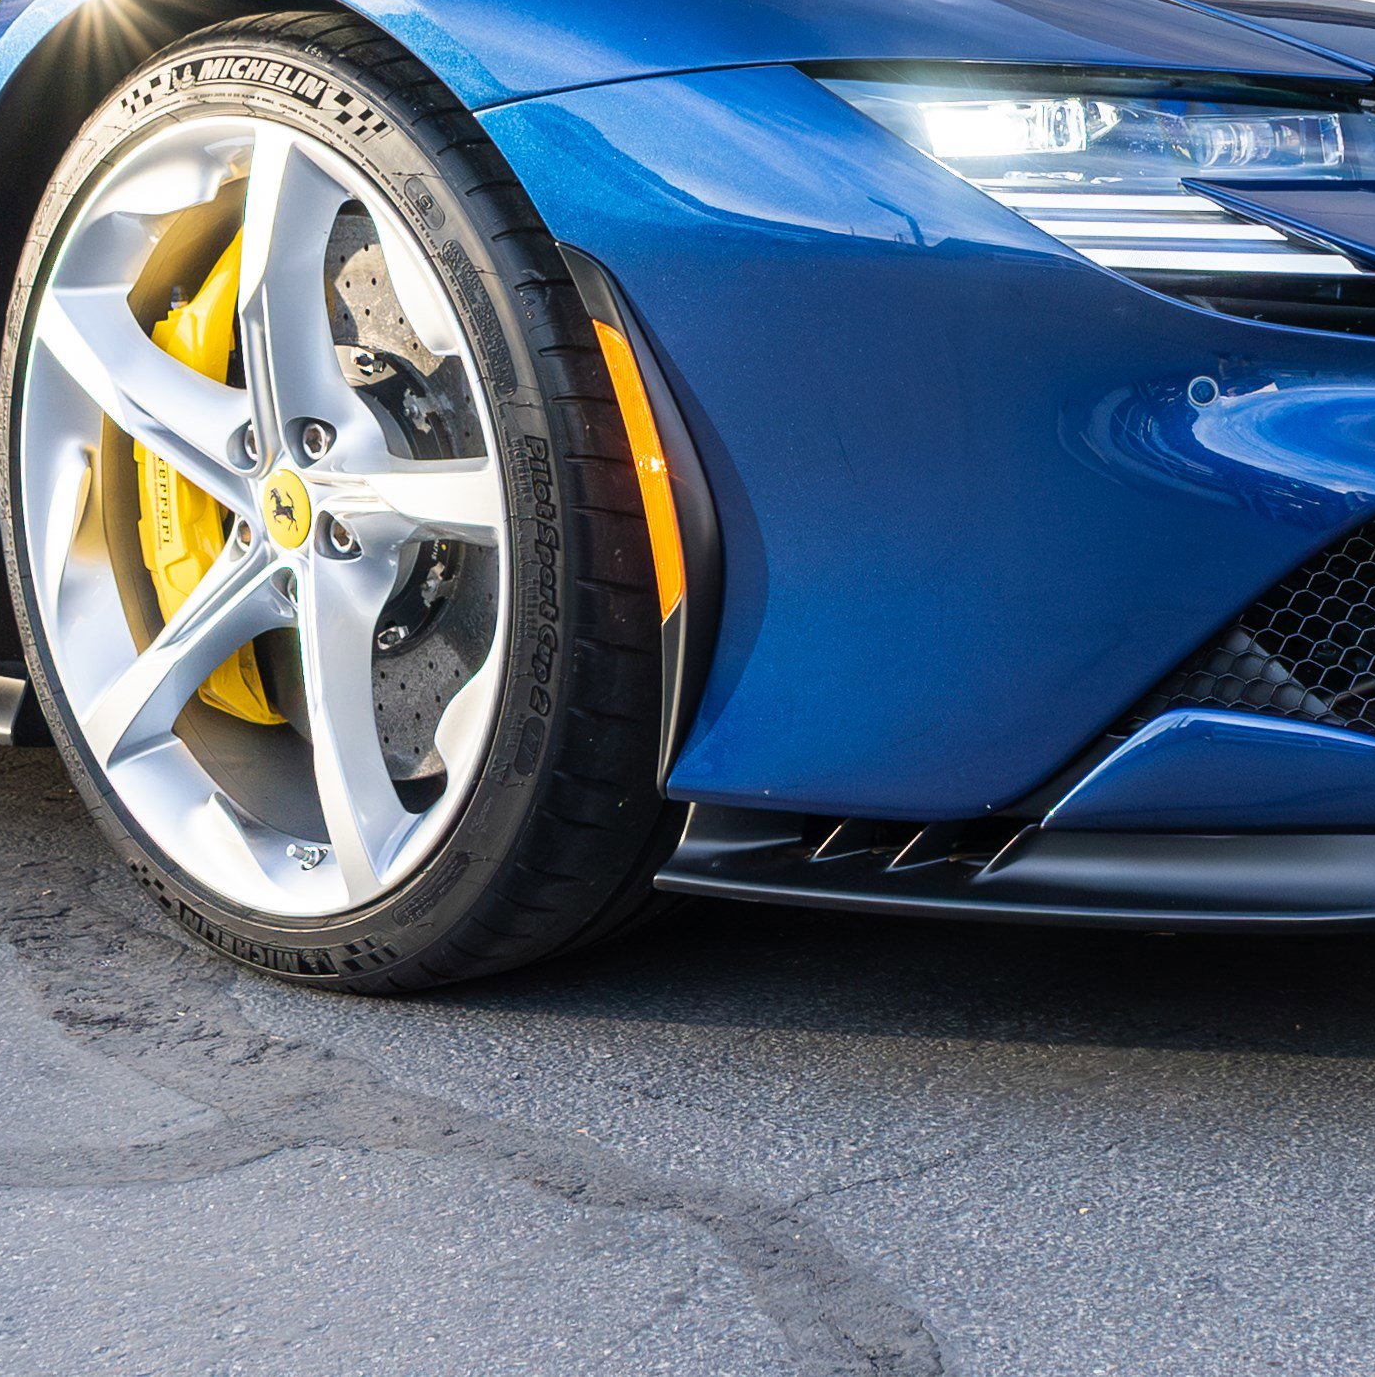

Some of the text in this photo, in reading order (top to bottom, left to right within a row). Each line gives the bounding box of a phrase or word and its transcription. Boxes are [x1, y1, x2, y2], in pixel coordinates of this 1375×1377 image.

[197, 56, 328, 101] MICHELIN
[524, 434, 557, 522] Pilot
[534, 521, 560, 622] Sport
[531, 623, 558, 684] Cup
[529, 685, 552, 717] 2
[181, 908, 301, 973] MICHELIN
